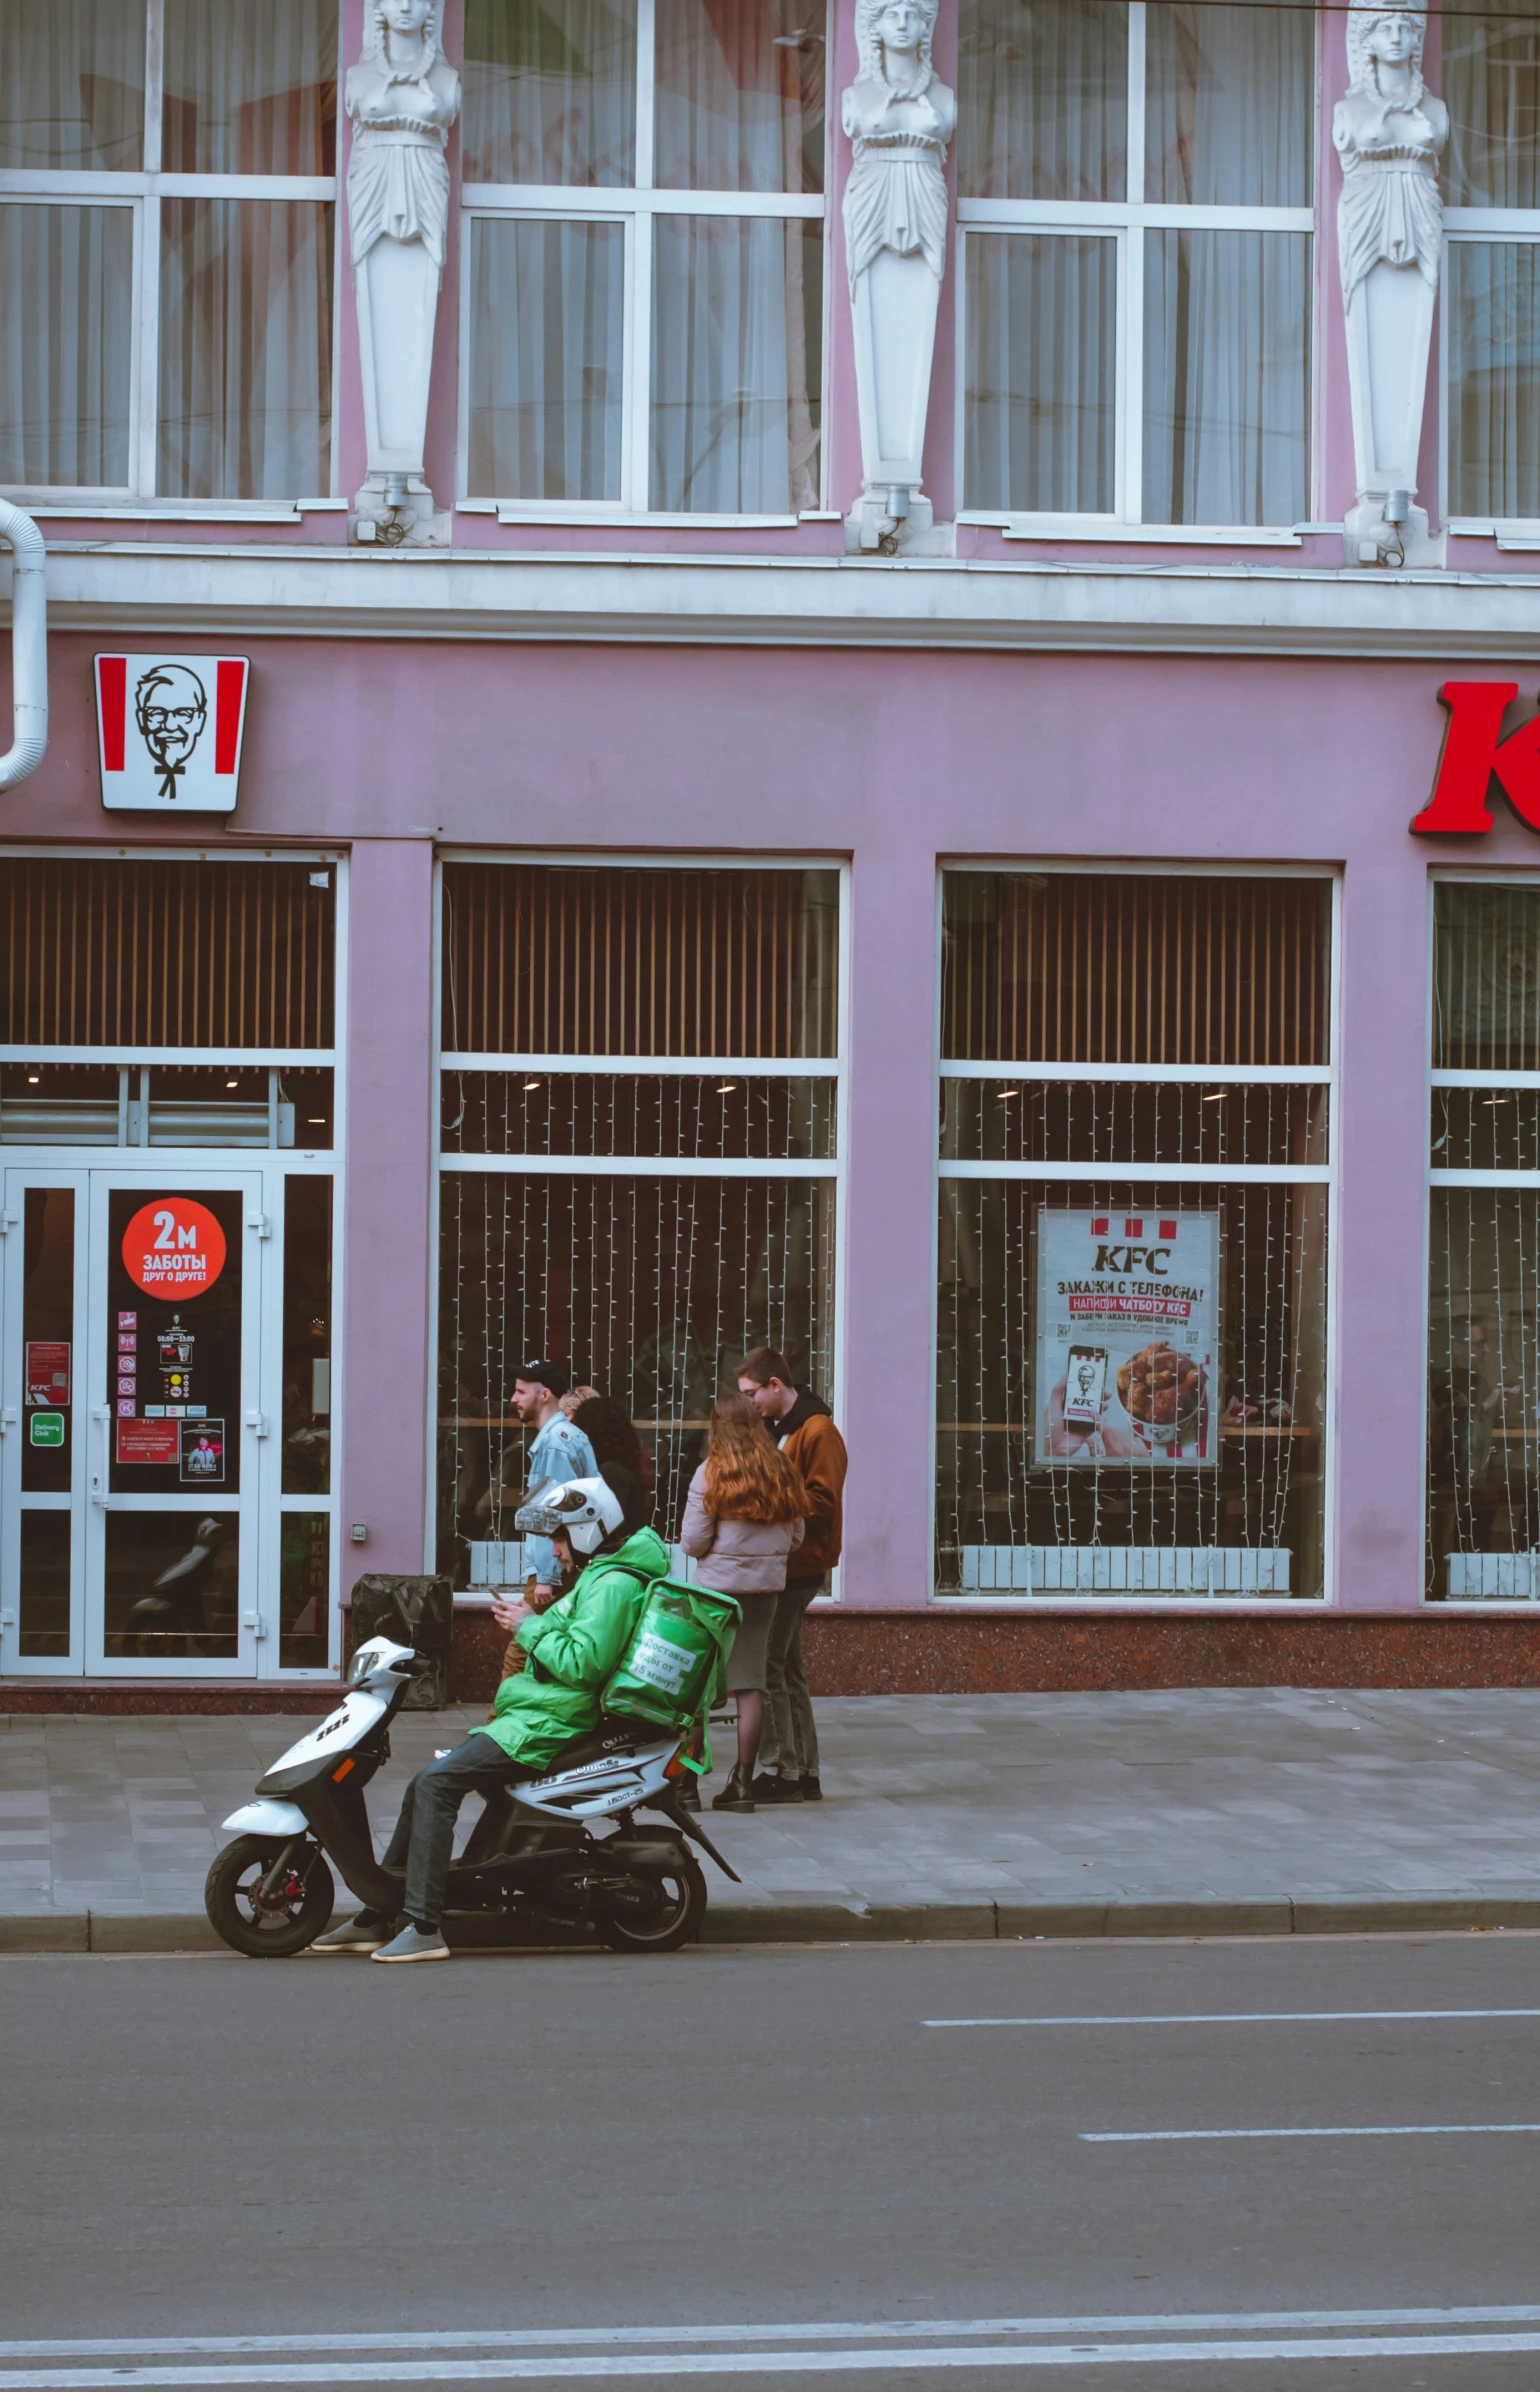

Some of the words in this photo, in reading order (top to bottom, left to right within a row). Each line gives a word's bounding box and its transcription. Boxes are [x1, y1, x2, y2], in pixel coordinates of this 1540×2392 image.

[142, 1254, 206, 1270] ЗАБОТЫ
[1092, 1245, 1171, 1275] KFC
[143, 1272, 165, 1283] ДРУГ
[167, 1272, 174, 1281] О
[175, 1272, 206, 1283] ДРУГЕ!
[1057, 1280, 1114, 1295] ЗАКАЖИ
[1118, 1280, 1126, 1294] С
[1130, 1281, 1204, 1302] ТЕЛЕФОНА!
[1073, 1297, 1117, 1309] НАПИШИ
[1119, 1298, 1165, 1313] ЧАТБОТУ
[1166, 1302, 1187, 1315] KFC
[1127, 1313, 1132, 1321] В
[1072, 1397, 1094, 1407] KFC
[34, 1424, 60, 1432] Delivery
[644, 1638, 690, 1666] Доставка
[639, 1652, 660, 1667] еды
[661, 1663, 674, 1672] от
[634, 1664, 646, 1674] 15
[646, 1671, 676, 1689] минут
